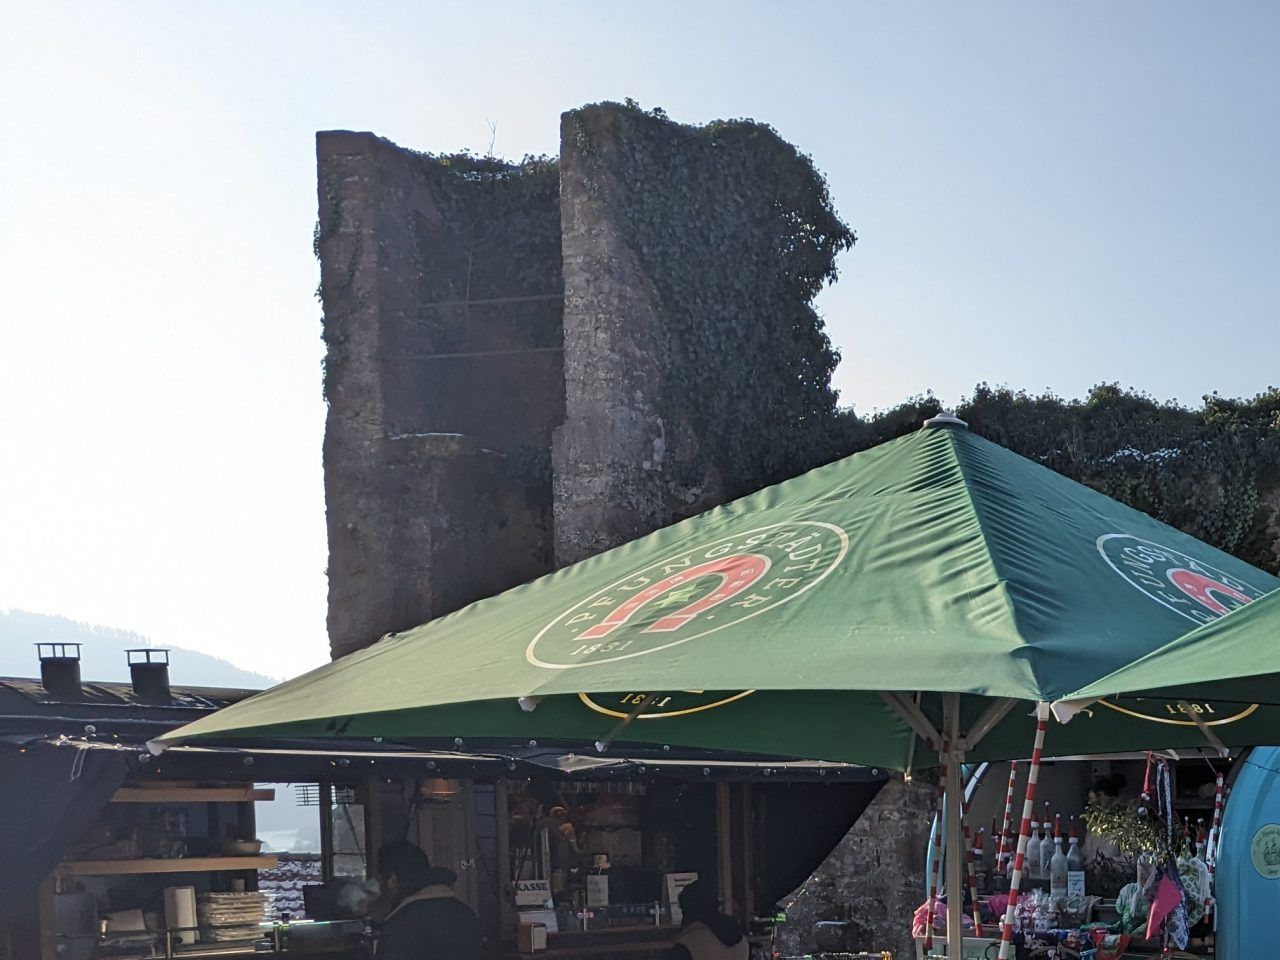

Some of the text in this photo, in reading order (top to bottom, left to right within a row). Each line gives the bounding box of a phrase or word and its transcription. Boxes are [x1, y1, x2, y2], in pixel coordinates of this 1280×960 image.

[564, 531, 825, 627] PFUNGSTÄDTER
[1119, 544, 1261, 622] PFUNGSTÄD
[569, 639, 634, 657] 1831
